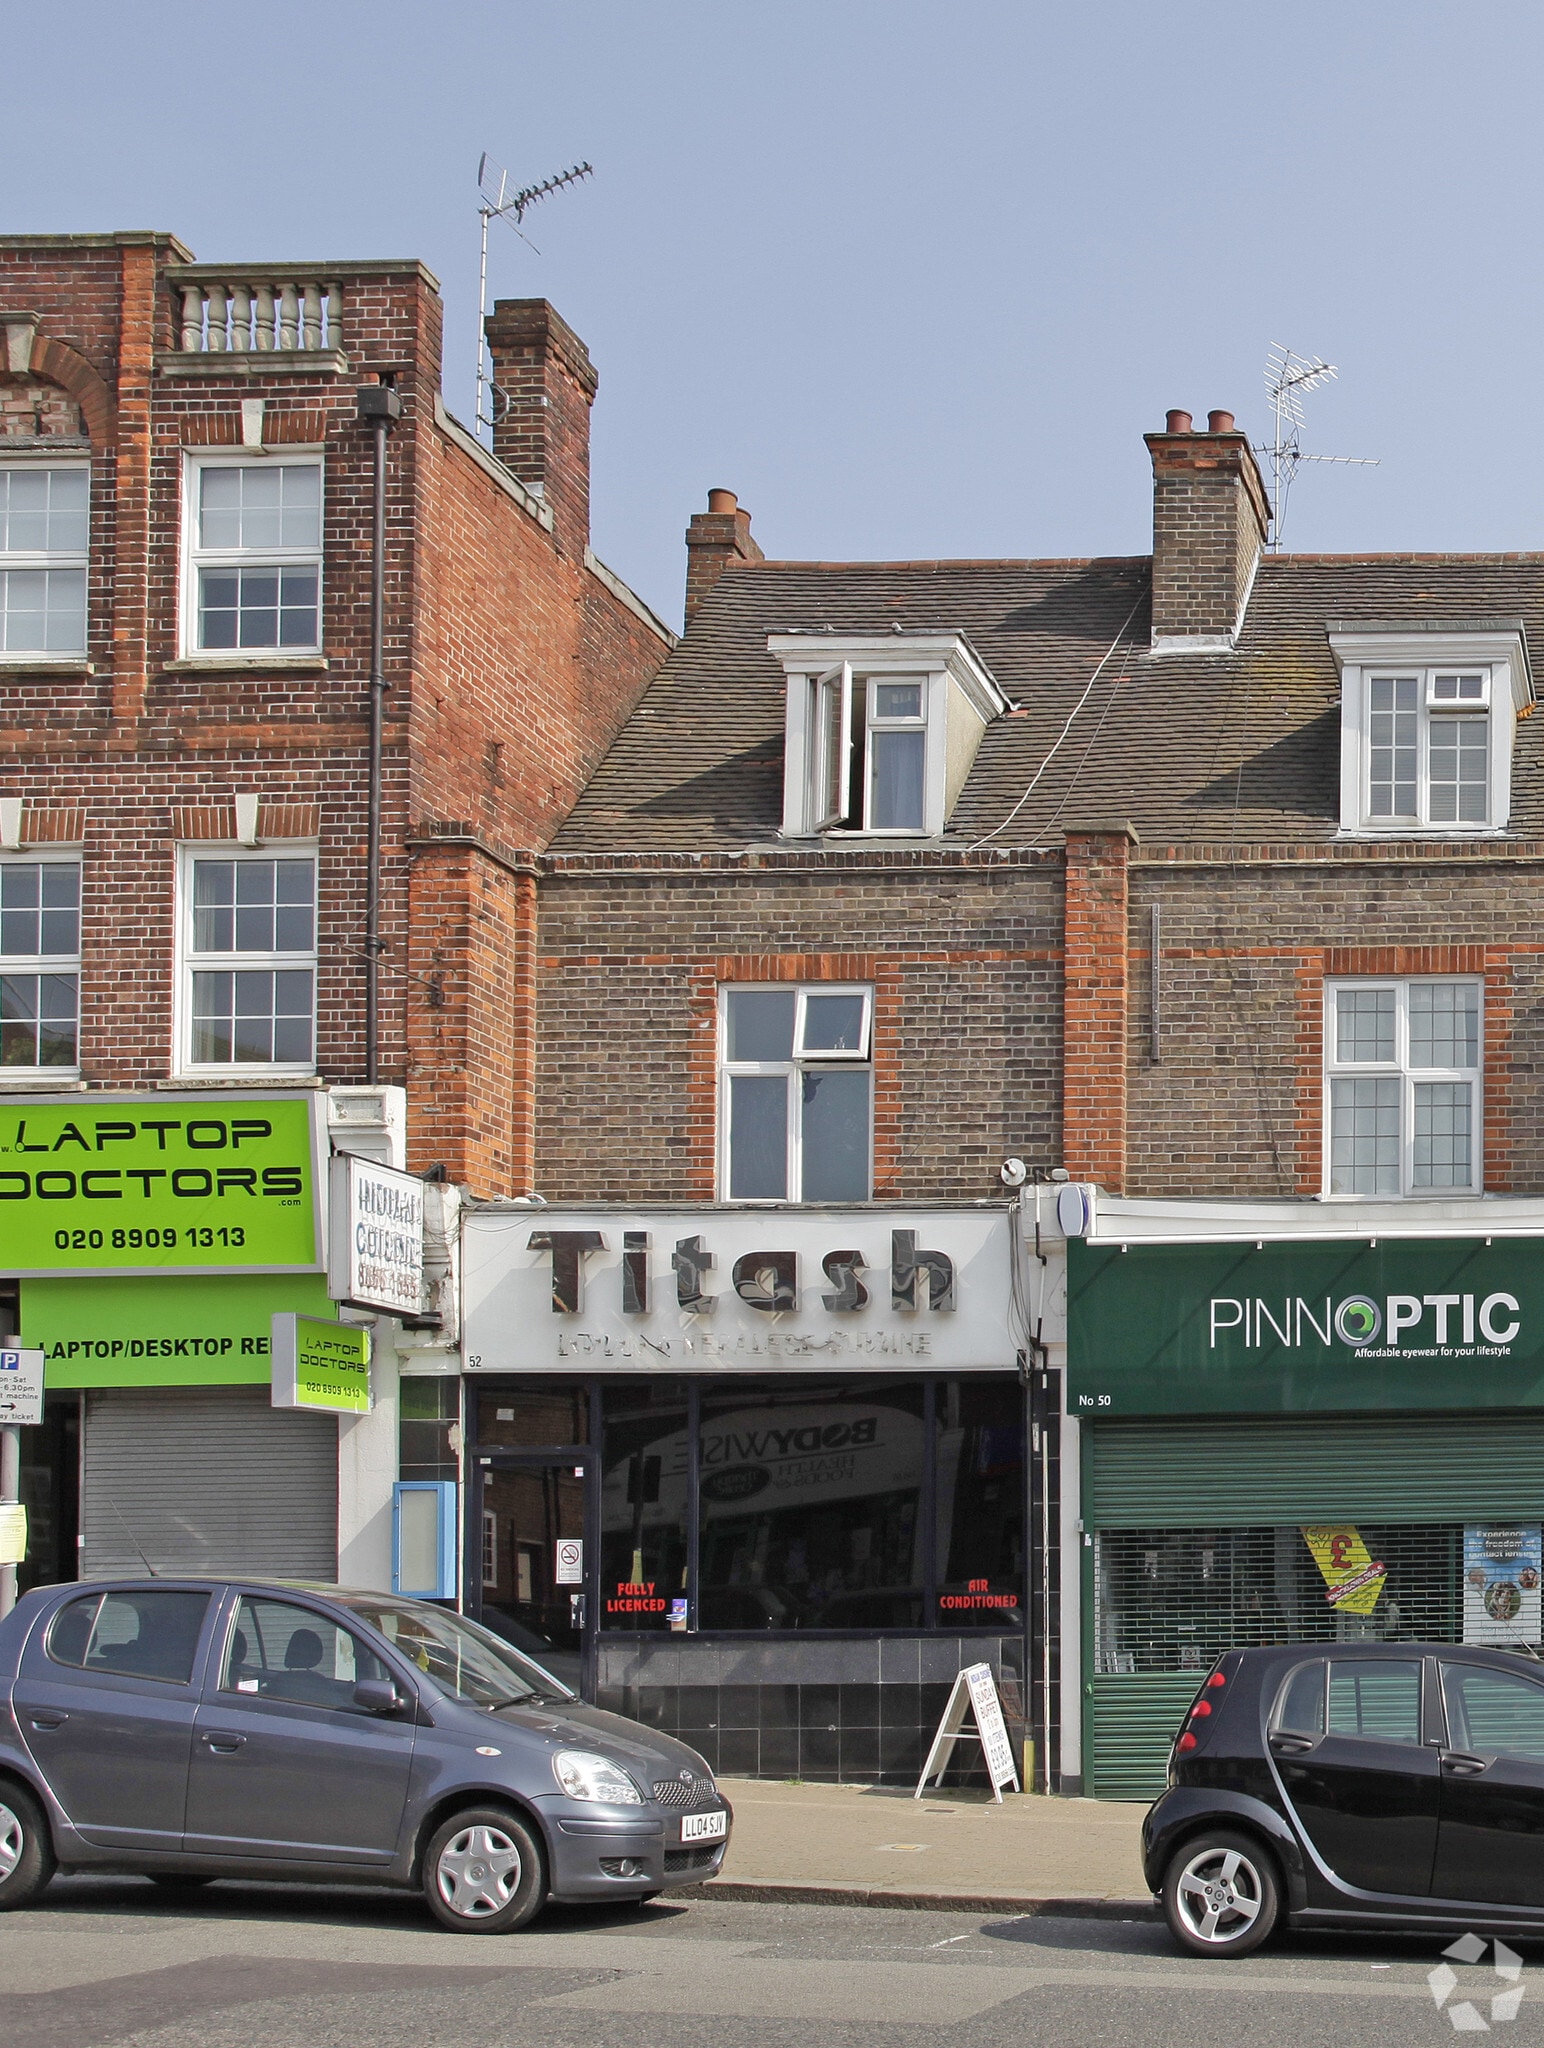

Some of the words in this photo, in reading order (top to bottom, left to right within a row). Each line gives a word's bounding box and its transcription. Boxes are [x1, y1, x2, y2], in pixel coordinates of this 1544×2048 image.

[15, 1120, 272, 1153] LAPTOP
[0, 1167, 302, 1199] DOCTORS
[278, 1199, 301, 1207] .com
[55, 1229, 104, 1250] 020
[112, 1228, 177, 1249] 8909
[185, 1227, 246, 1248] 1313
[525, 1228, 957, 1315] Titash
[241, 1337, 272, 1354] RE
[306, 1337, 360, 1356] LAPTOP
[1354, 1347, 1400, 1359] Affordable
[1402, 1348, 1438, 1359] eyewear
[1440, 1346, 1453, 1357] for
[1454, 1348, 1475, 1358] your
[1476, 1345, 1511, 1357] lifestyle
[4, 1353, 16, 1369] P
[300, 1353, 365, 1374] DOCTORS
[469, 1355, 482, 1368] 52
[306, 1382, 321, 1393] 020
[344, 1387, 360, 1399] 1313
[1079, 1394, 1094, 1406] No
[1098, 1394, 1111, 1406] 50
[617, 1582, 655, 1597] FULLY
[968, 1579, 989, 1593] AIR
[607, 1599, 666, 1612] LICENCED
[940, 1594, 1018, 1609] CONDITIONED
[685, 1817, 708, 1837] LL04
